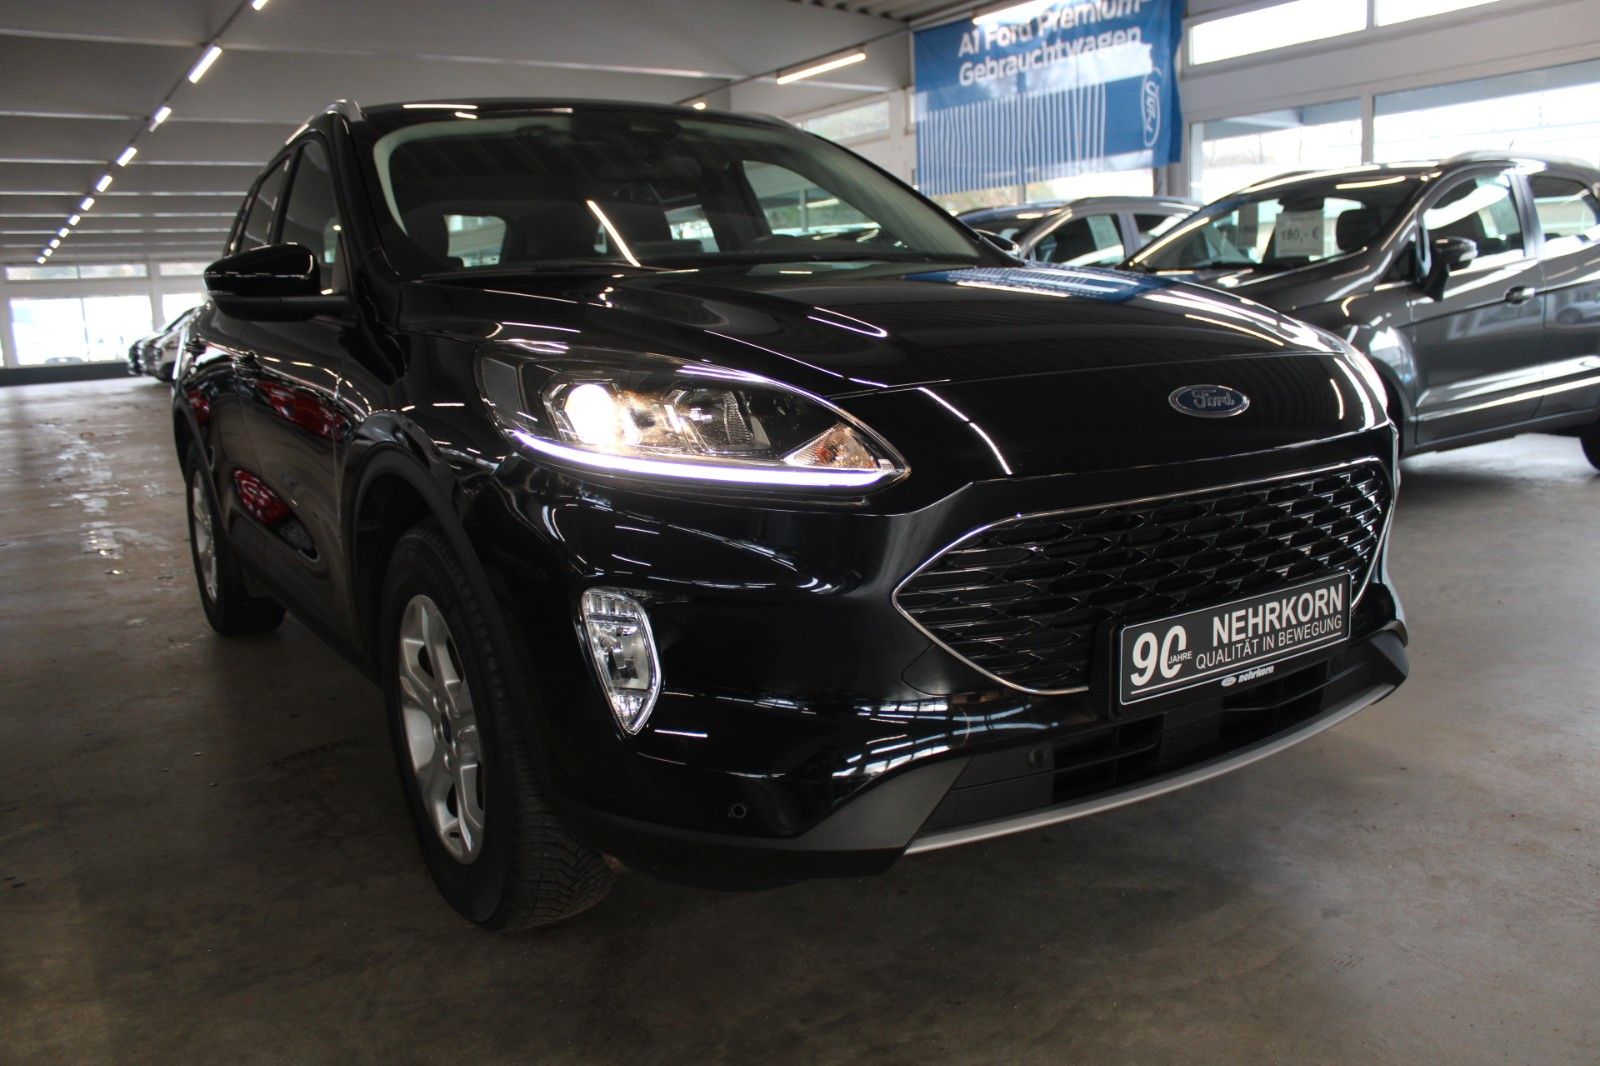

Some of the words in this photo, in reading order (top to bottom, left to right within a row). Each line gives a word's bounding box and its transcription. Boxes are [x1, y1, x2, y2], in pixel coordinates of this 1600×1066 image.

[959, 26, 1141, 86] Gebrauchtwagen
[984, 17, 1033, 51] Ford
[1191, 390, 1235, 409] Ford
[1213, 583, 1342, 647] NEHRKORN
[1131, 625, 1187, 686] 90
[1168, 651, 1193, 665] JAHRE
[1196, 639, 1259, 670] QUALITÄT
[1263, 635, 1275, 651] IN
[1278, 614, 1343, 647] BEWEGUNG
[1237, 665, 1275, 683] nehrkorn
